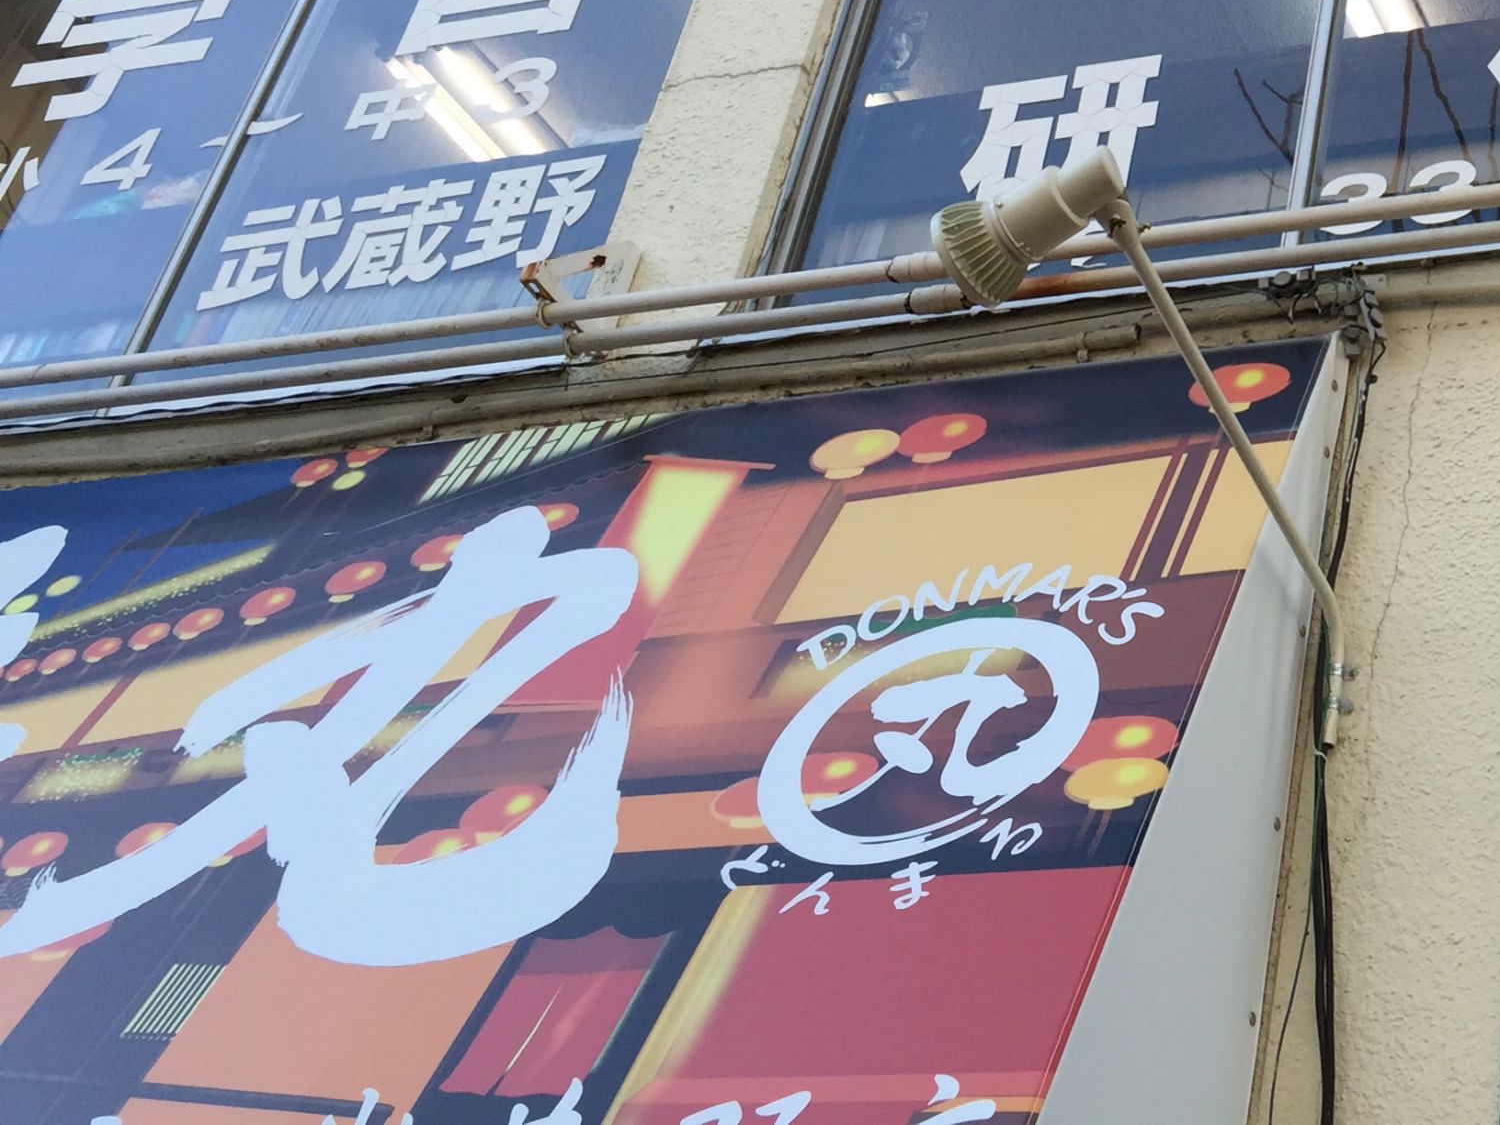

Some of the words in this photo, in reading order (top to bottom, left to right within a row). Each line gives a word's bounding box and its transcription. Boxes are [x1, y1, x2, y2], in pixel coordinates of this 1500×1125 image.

[197, 154, 606, 311] 武蔵野
[797, 562, 1165, 670] DONMAR'S
[0, 505, 638, 966] 丸
